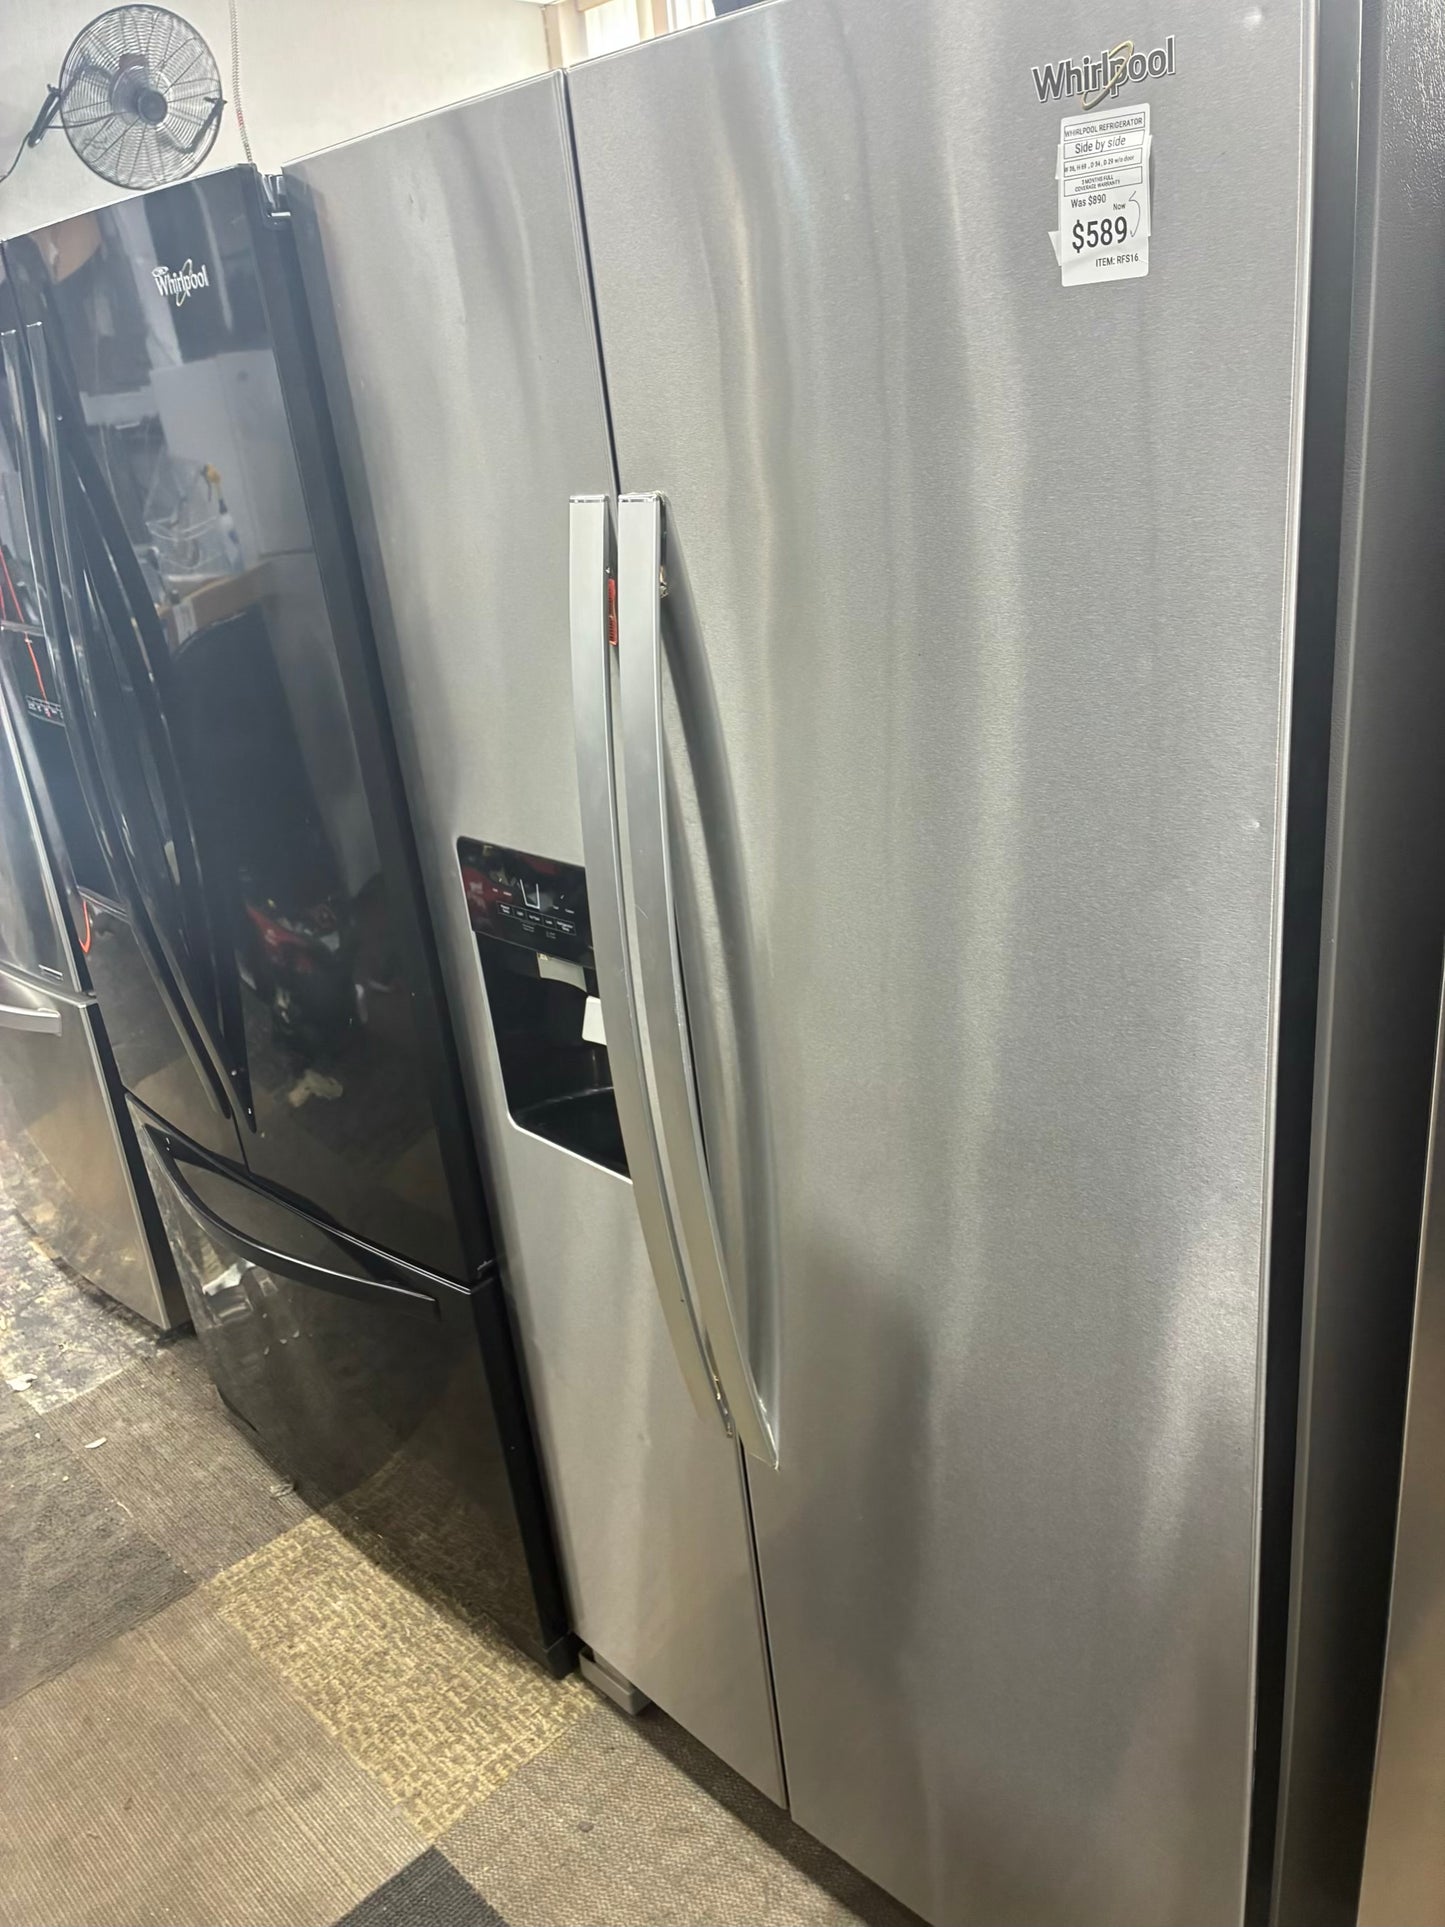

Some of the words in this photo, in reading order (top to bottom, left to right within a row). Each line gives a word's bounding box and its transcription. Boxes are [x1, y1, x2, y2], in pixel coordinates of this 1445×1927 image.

[1031, 34, 1176, 103] Whirlpool
[1064, 125, 1098, 137] WHIRLPOOL
[1099, 117, 1143, 131] REFRIGERATOR
[1075, 141, 1093, 154] Side
[1095, 139, 1105, 152] by
[1107, 135, 1126, 148] side
[1074, 184, 1096, 193] COVERAGE
[1097, 179, 1121, 188] WARRANTY
[1085, 176, 1103, 184] MONTHS
[1070, 198, 1086, 208] Was
[1088, 193, 1107, 206] $890
[1112, 203, 1126, 211] Now
[1072, 216, 1127, 253] $589
[1095, 256, 1115, 267] ITEM:
[1116, 253, 1139, 264] RFS16
[154, 264, 210, 297] Whirlpool
